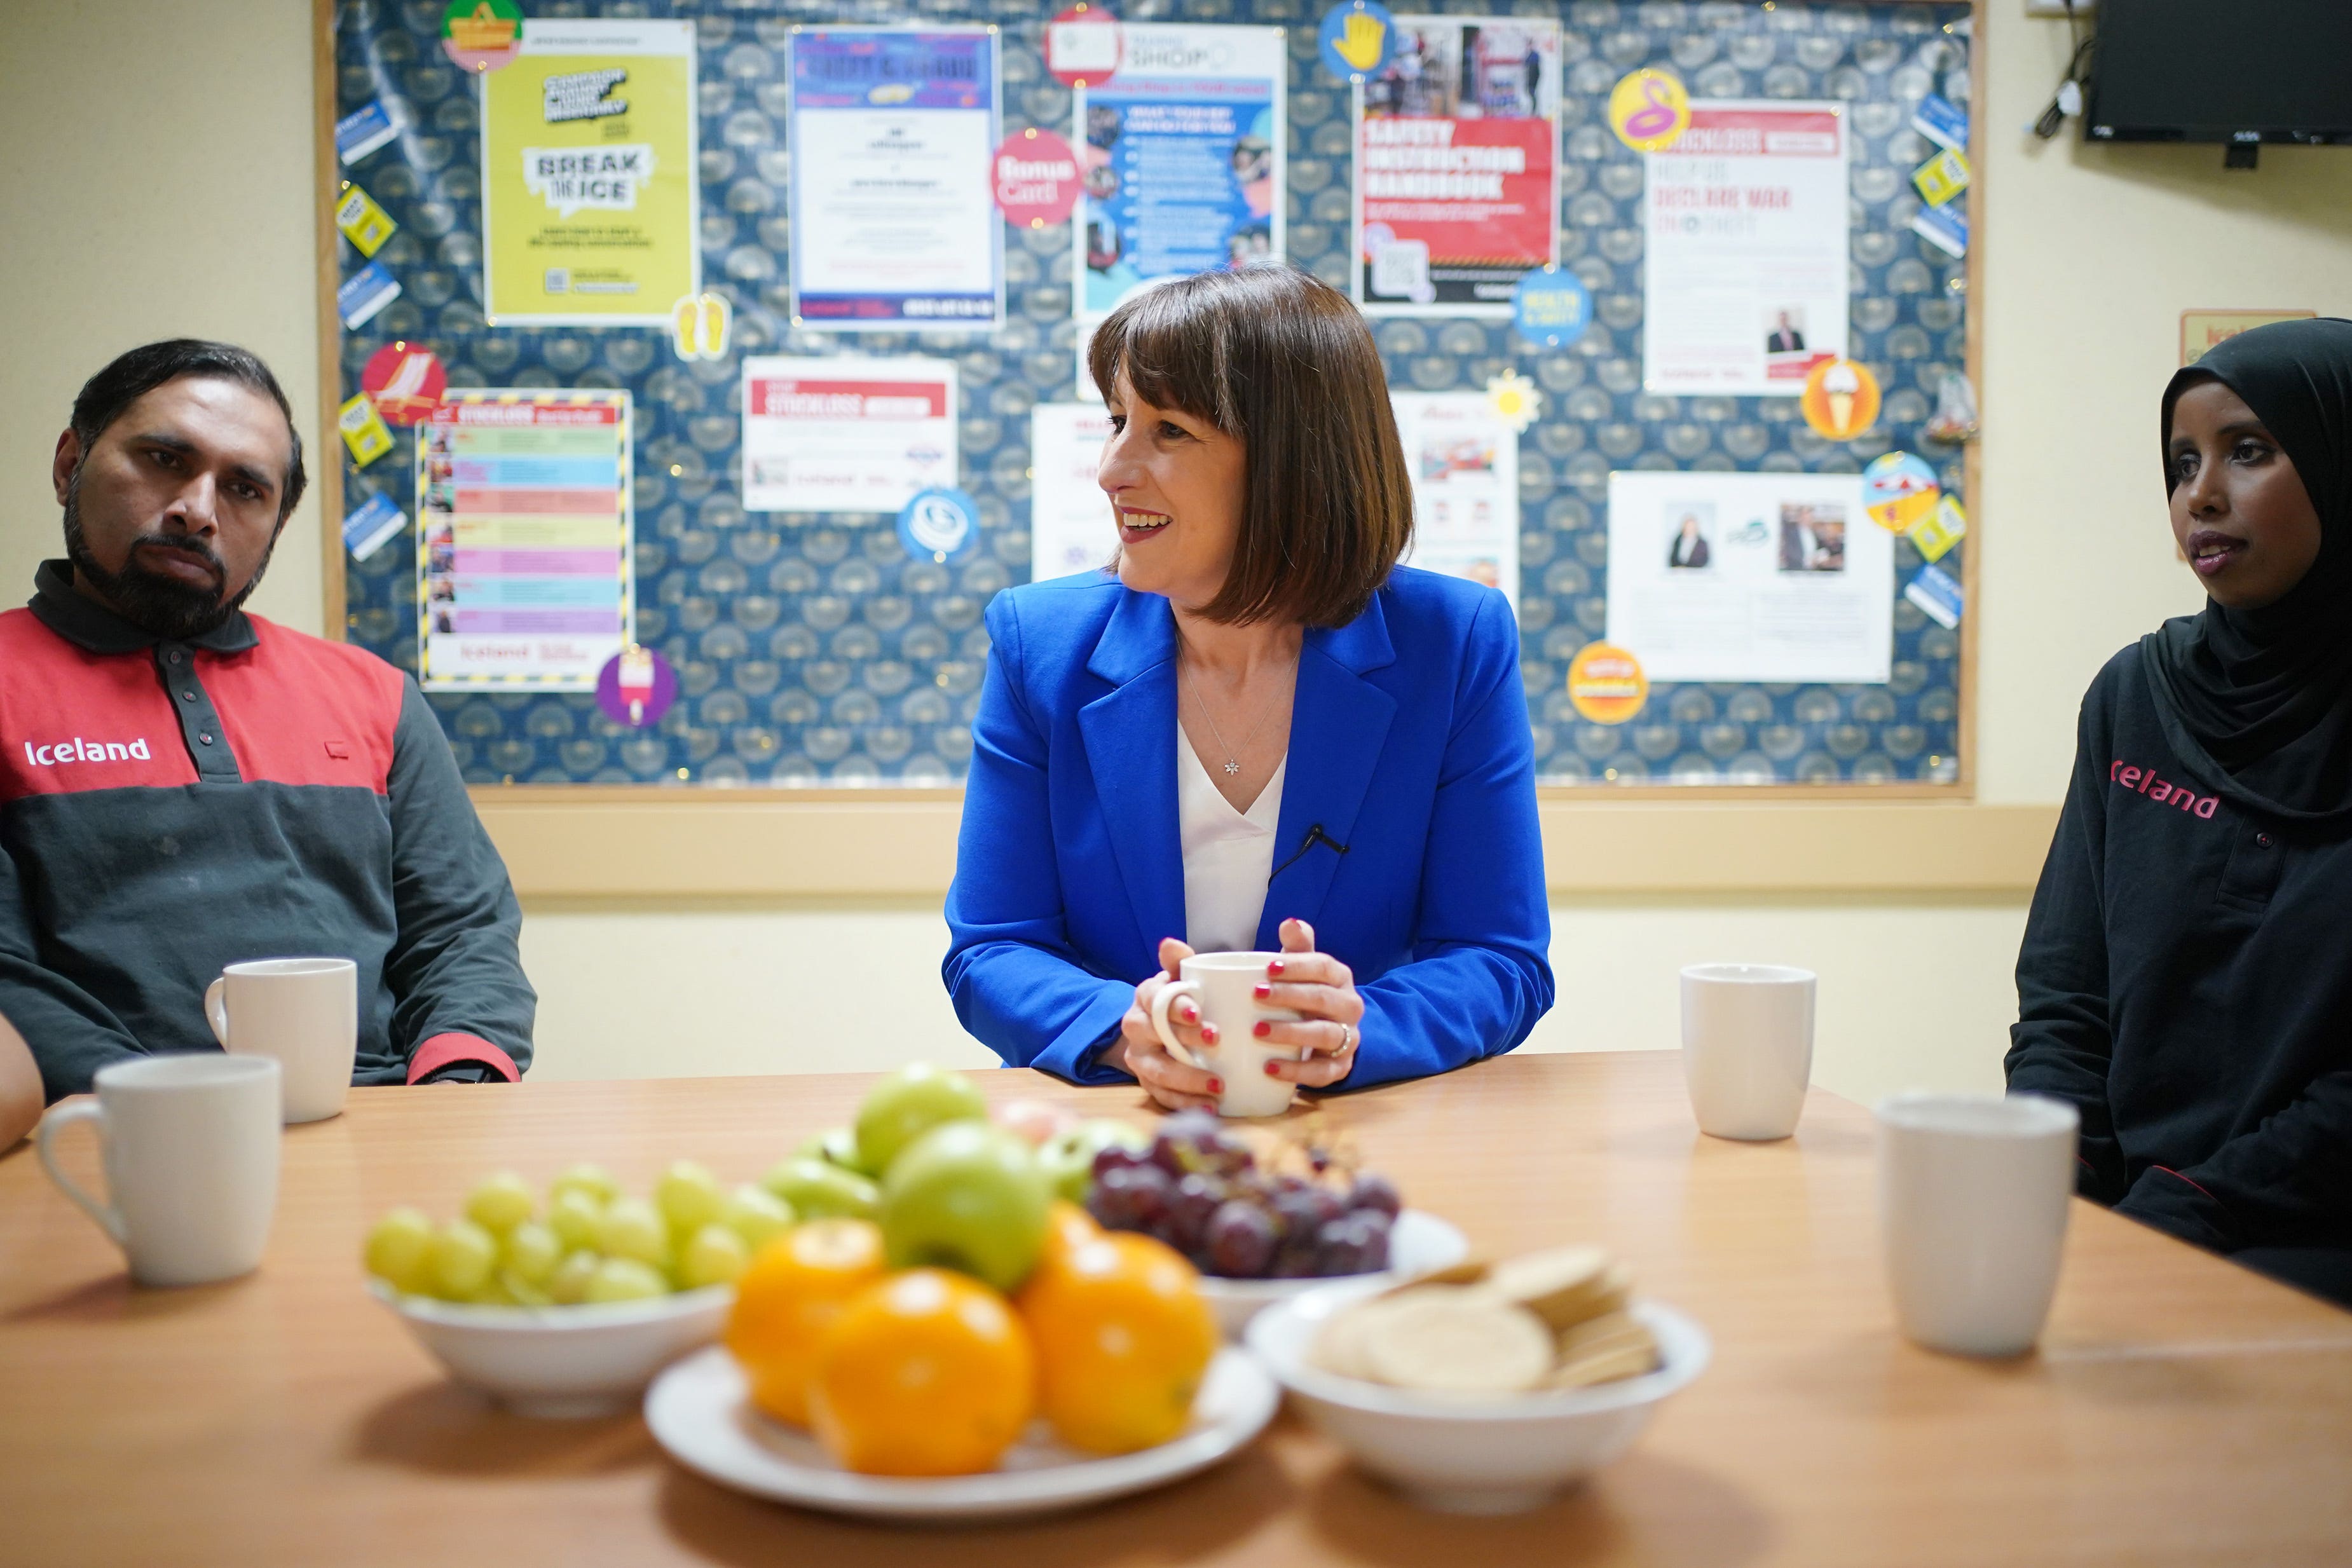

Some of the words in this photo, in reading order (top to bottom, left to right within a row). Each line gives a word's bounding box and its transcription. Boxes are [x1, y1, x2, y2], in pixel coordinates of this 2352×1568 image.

[538, 153, 639, 177] BREAK
[998, 156, 1076, 182] Bonus
[580, 180, 626, 201] ICE
[997, 181, 1058, 205] Card
[766, 393, 862, 415] STOCKLOSS
[25, 737, 151, 767] Iceland
[2110, 760, 2220, 819] celand
